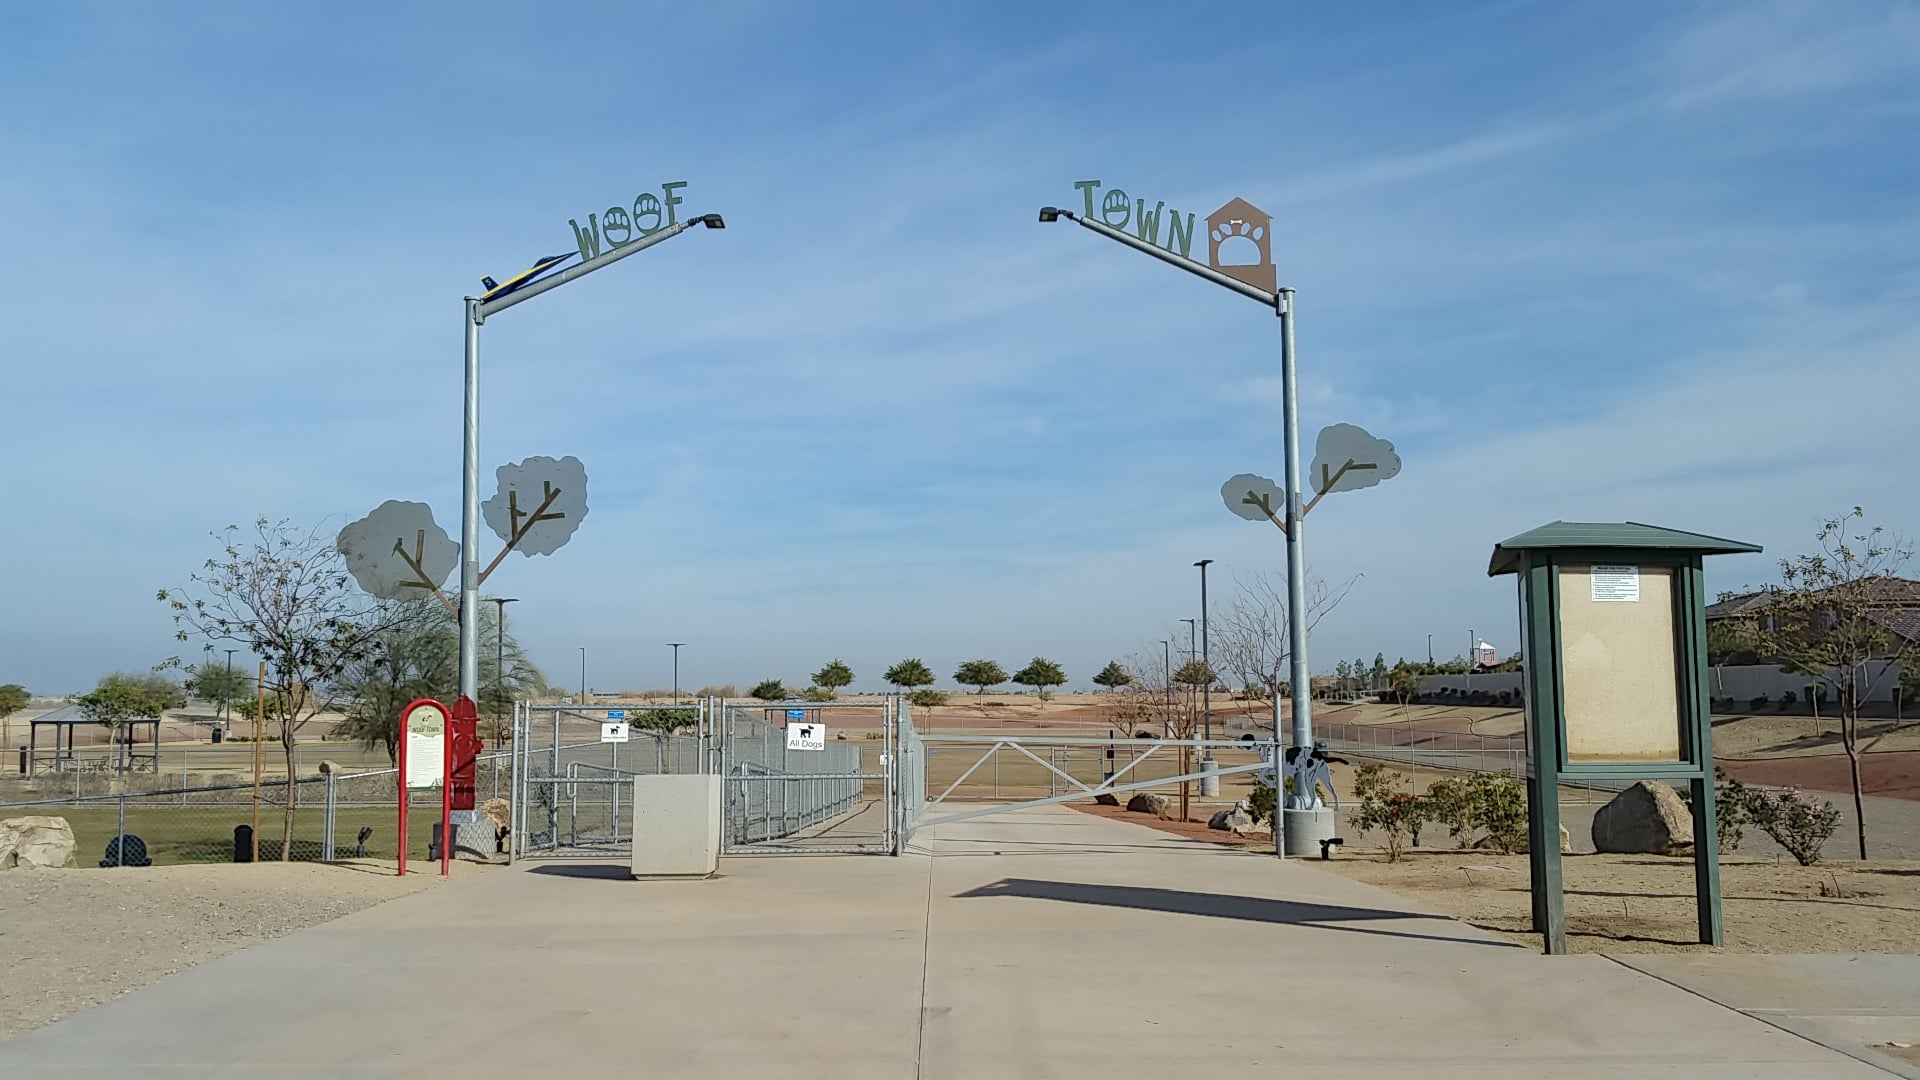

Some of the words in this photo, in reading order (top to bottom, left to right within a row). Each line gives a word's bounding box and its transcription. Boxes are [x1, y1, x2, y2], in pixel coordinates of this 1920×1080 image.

[568, 180, 688, 263] WOOF
[1073, 179, 1196, 259] TOWN
[790, 739, 800, 747] All
[802, 740, 823, 750] Dogs
